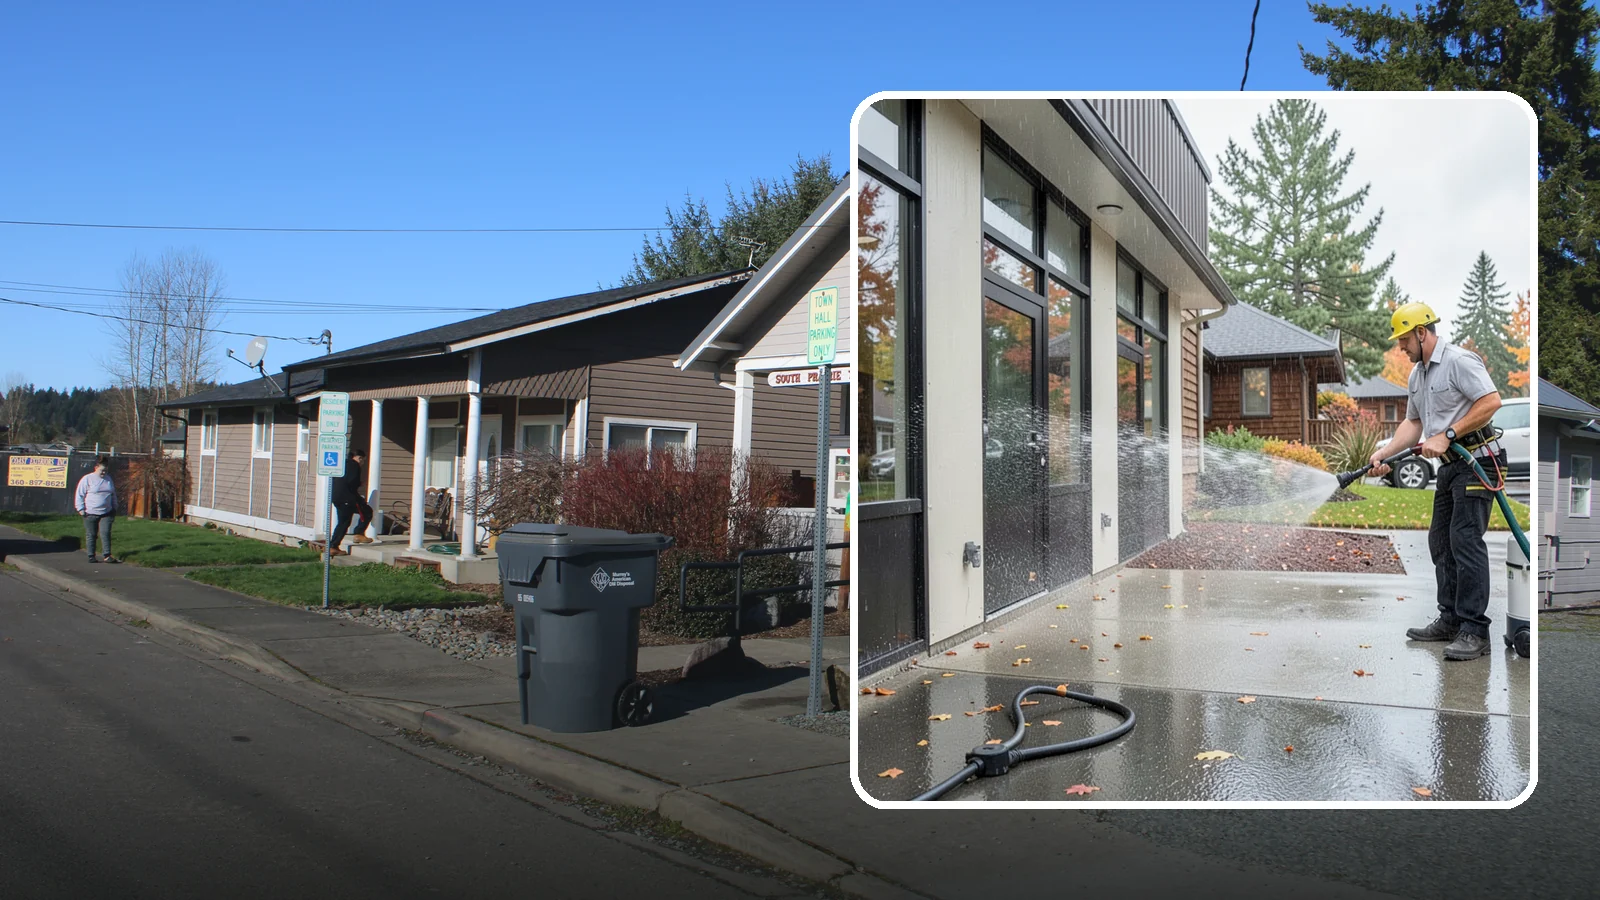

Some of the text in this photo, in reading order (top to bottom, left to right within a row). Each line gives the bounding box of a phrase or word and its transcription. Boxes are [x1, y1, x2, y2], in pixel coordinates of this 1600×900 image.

[815, 294, 833, 307] TOWN
[814, 312, 831, 324] HALL
[810, 327, 836, 340] PARKING
[813, 344, 831, 357] ONLY
[775, 373, 801, 384] SOUTH
[808, 371, 841, 382] PRIE
